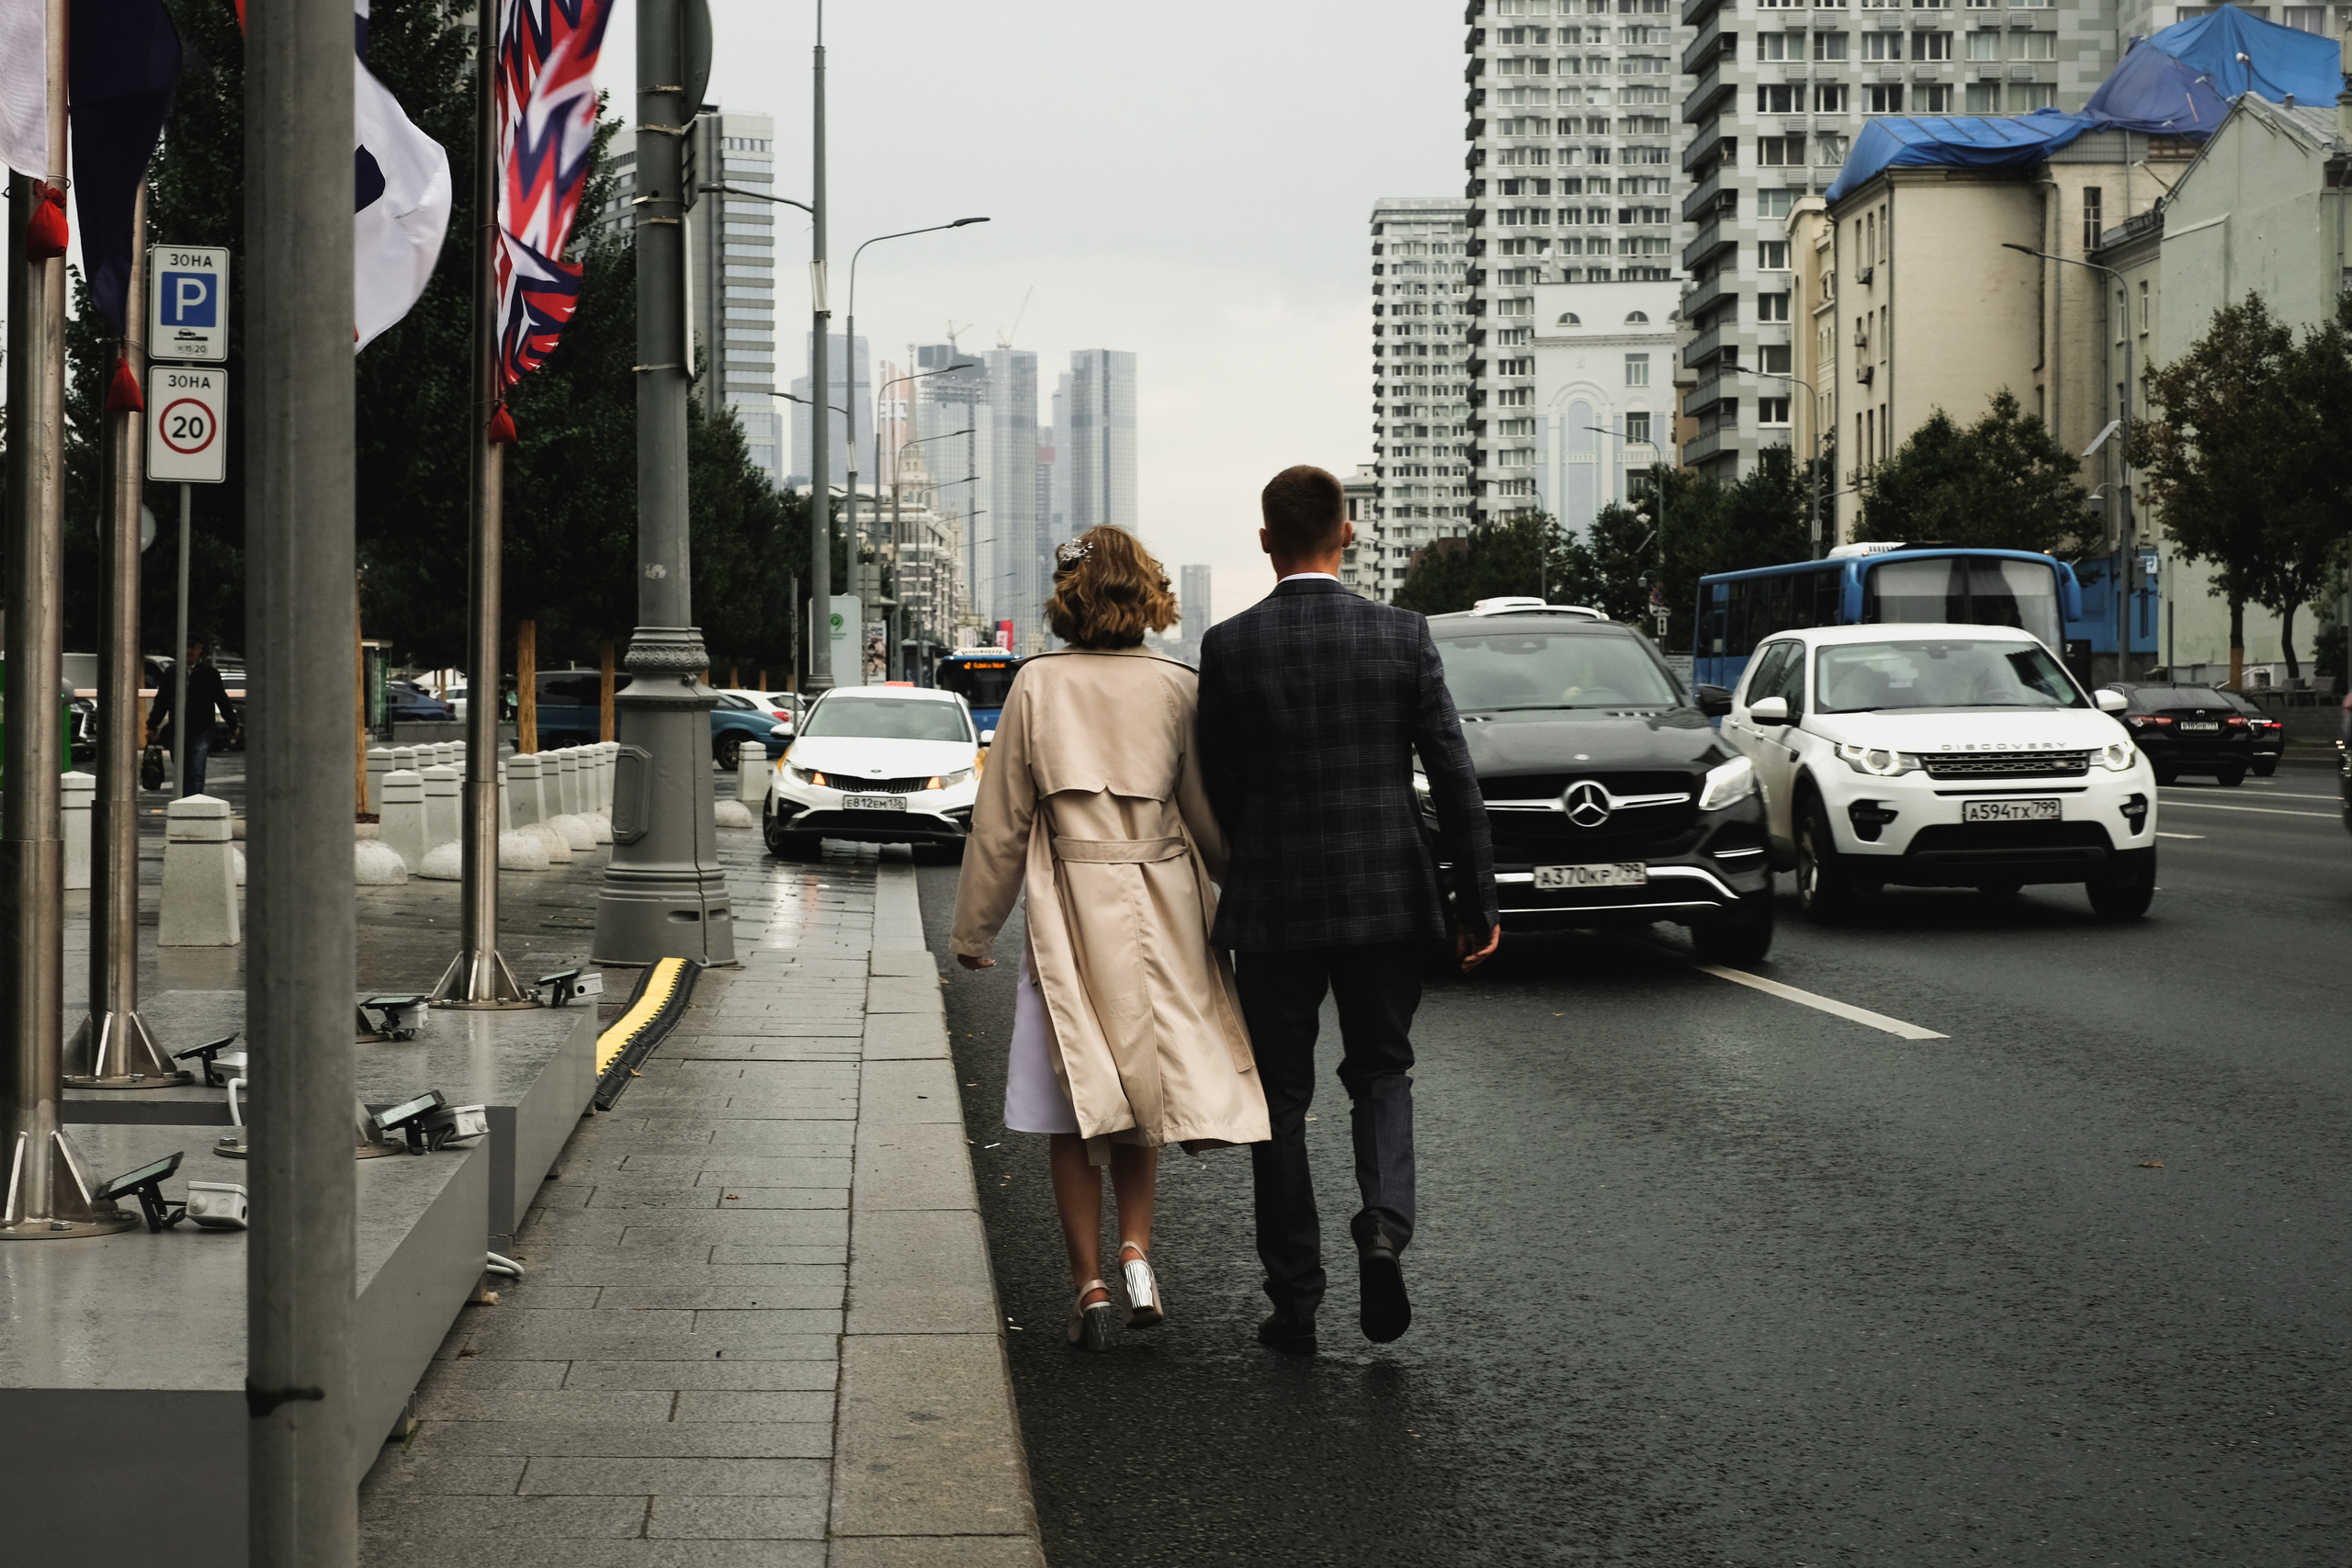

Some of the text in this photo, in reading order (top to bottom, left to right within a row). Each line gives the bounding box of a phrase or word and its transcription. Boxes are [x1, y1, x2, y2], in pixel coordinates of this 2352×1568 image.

[170, 254, 213, 267] ЗОНА
[175, 277, 208, 321] P
[195, 344, 206, 354] 20
[168, 375, 211, 389] ЗОНА
[172, 416, 204, 439] 20
[1941, 742, 2066, 751] DISCOVERY
[1970, 801, 2058, 820] А594ТХ 799
